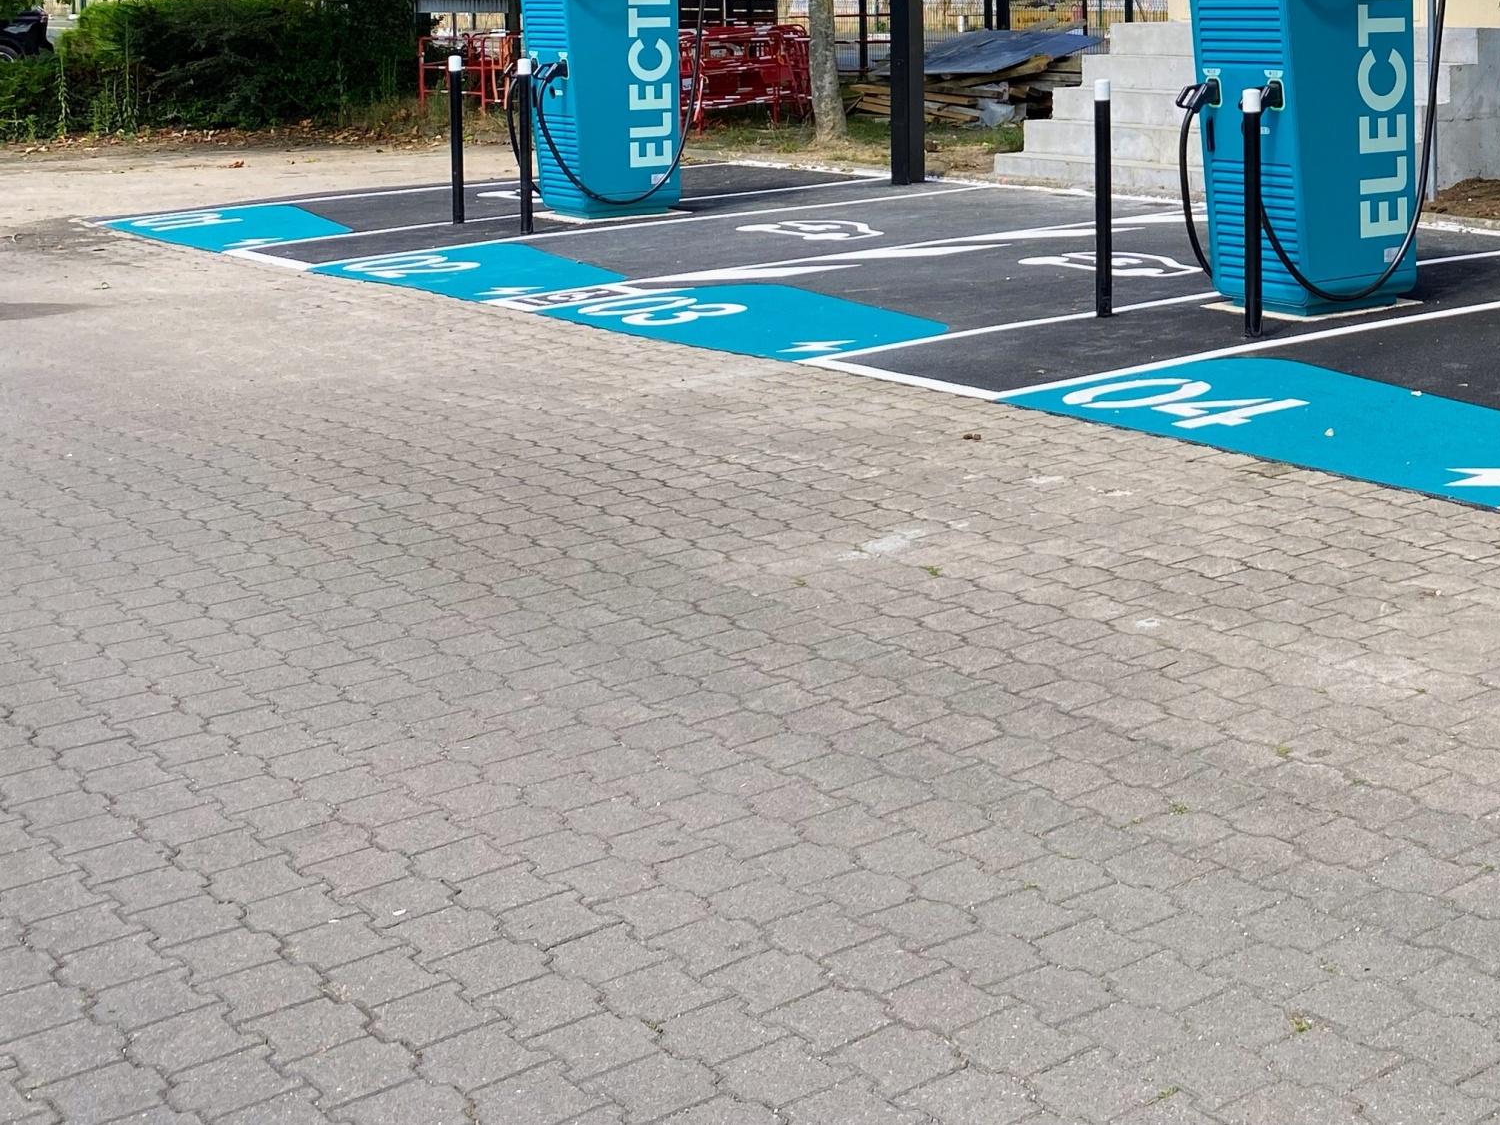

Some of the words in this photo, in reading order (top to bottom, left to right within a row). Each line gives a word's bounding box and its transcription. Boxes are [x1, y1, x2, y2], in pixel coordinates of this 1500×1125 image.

[130, 213, 244, 232] 01
[342, 255, 482, 279] 02
[577, 296, 748, 326] 03
[1062, 378, 1310, 429] 04
